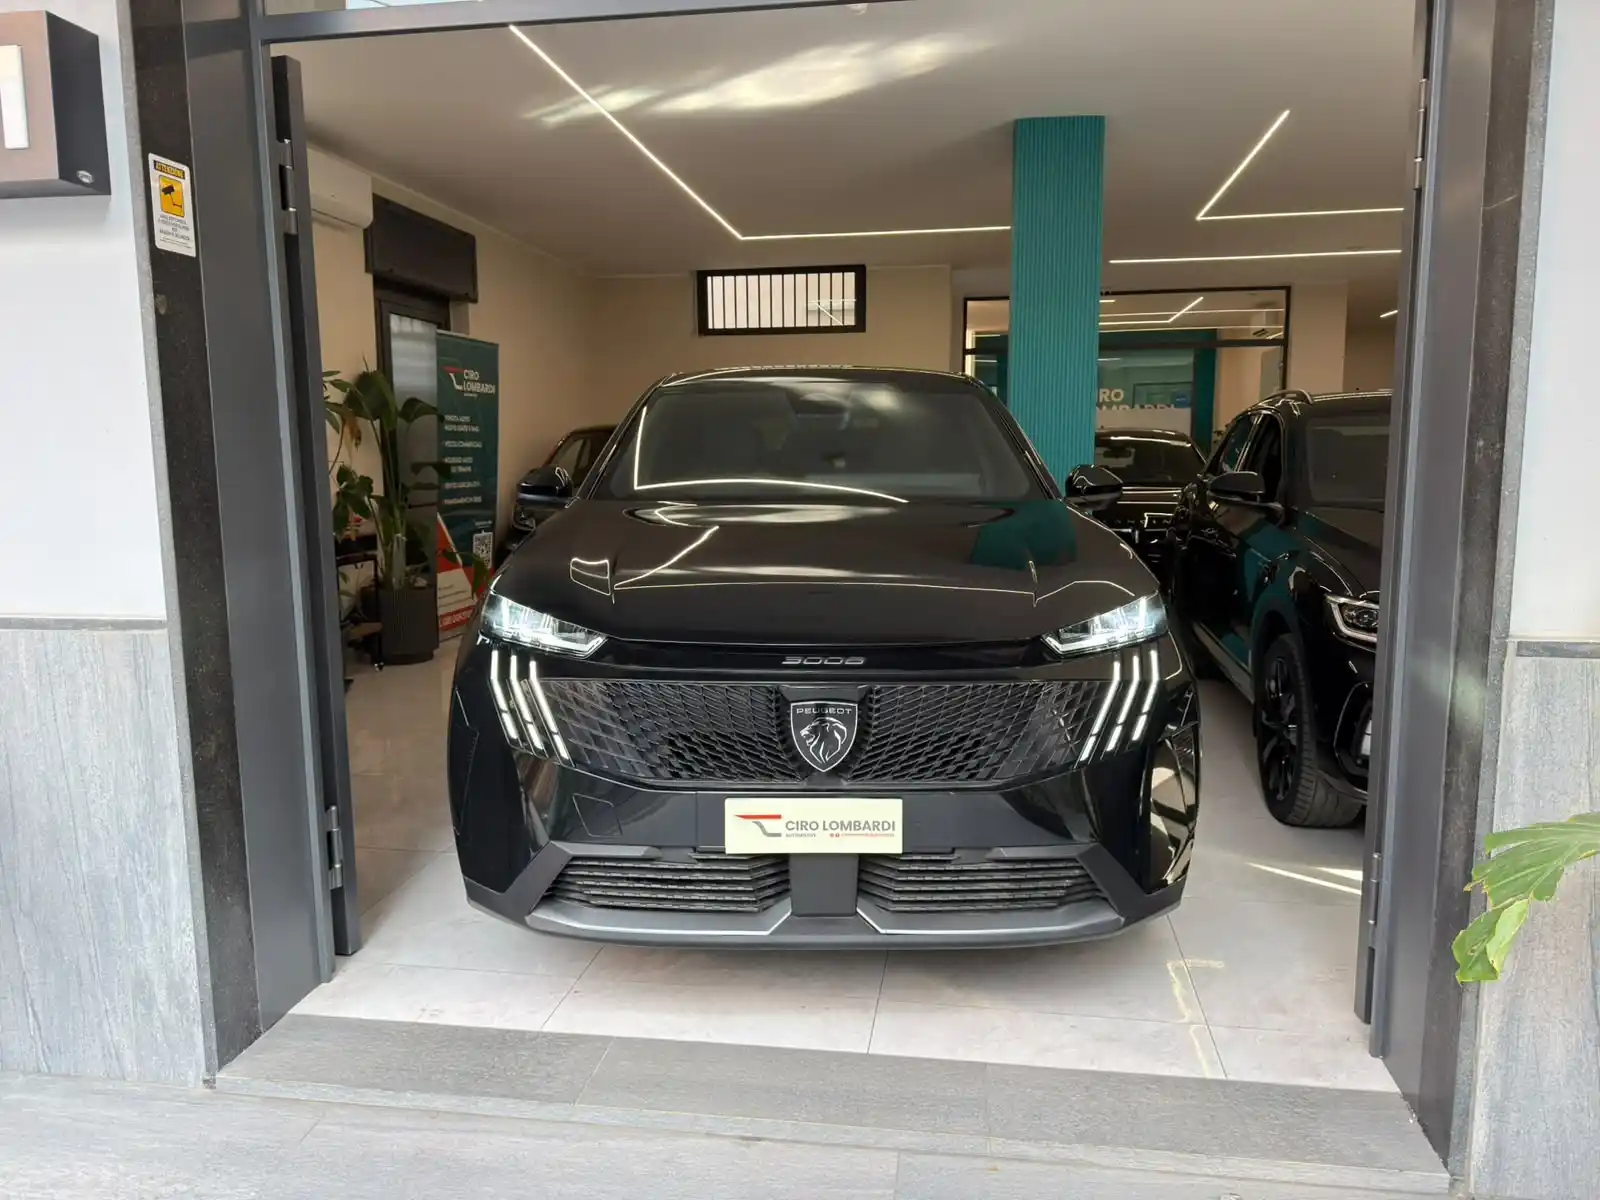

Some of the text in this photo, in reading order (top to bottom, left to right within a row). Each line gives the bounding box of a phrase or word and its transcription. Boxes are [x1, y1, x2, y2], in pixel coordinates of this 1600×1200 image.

[463, 369, 480, 380] CIRO
[463, 380, 496, 394] LOMBARDI
[796, 707, 853, 715] PEUGEOT
[785, 819, 897, 832] CIRO LOMBARDI
